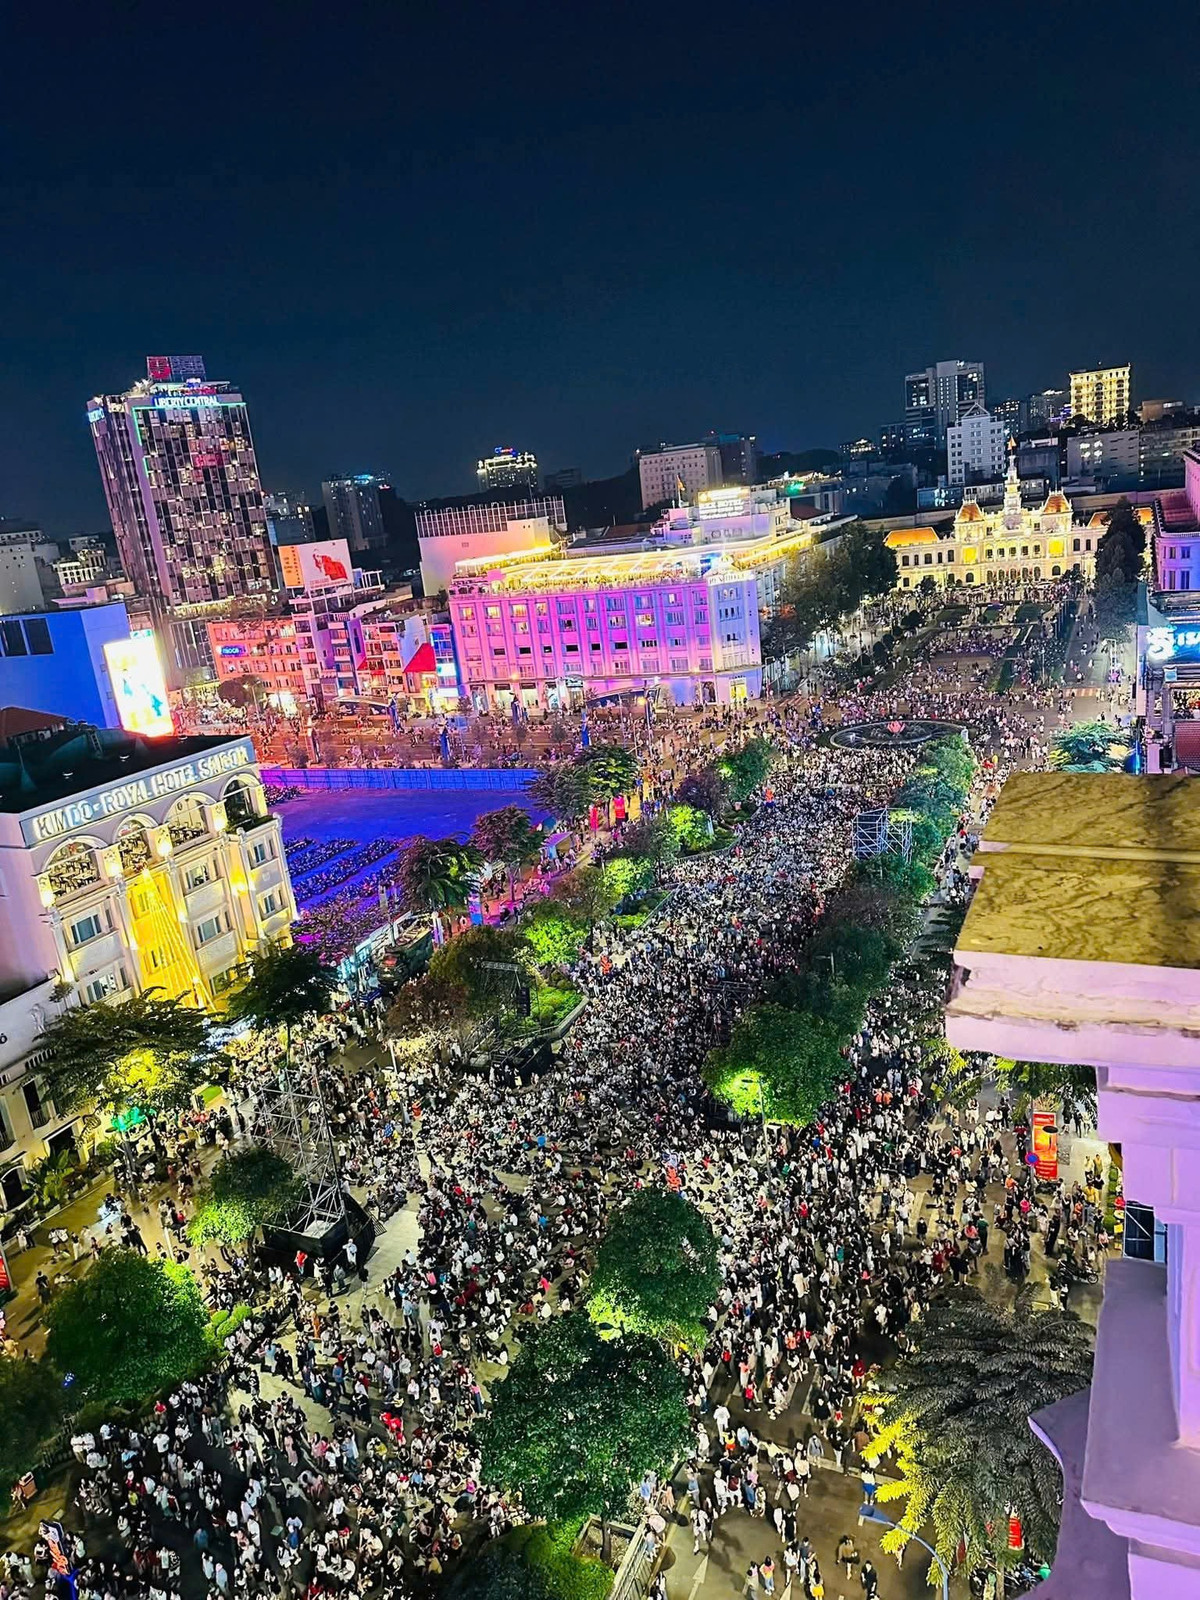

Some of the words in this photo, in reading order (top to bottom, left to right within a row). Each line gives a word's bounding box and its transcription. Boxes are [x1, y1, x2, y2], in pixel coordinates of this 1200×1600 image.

[154, 397, 184, 408] LIBERTY
[184, 395, 219, 407] CENTRAL
[151, 764, 199, 795] HOTEL
[198, 746, 249, 777] SAIGON
